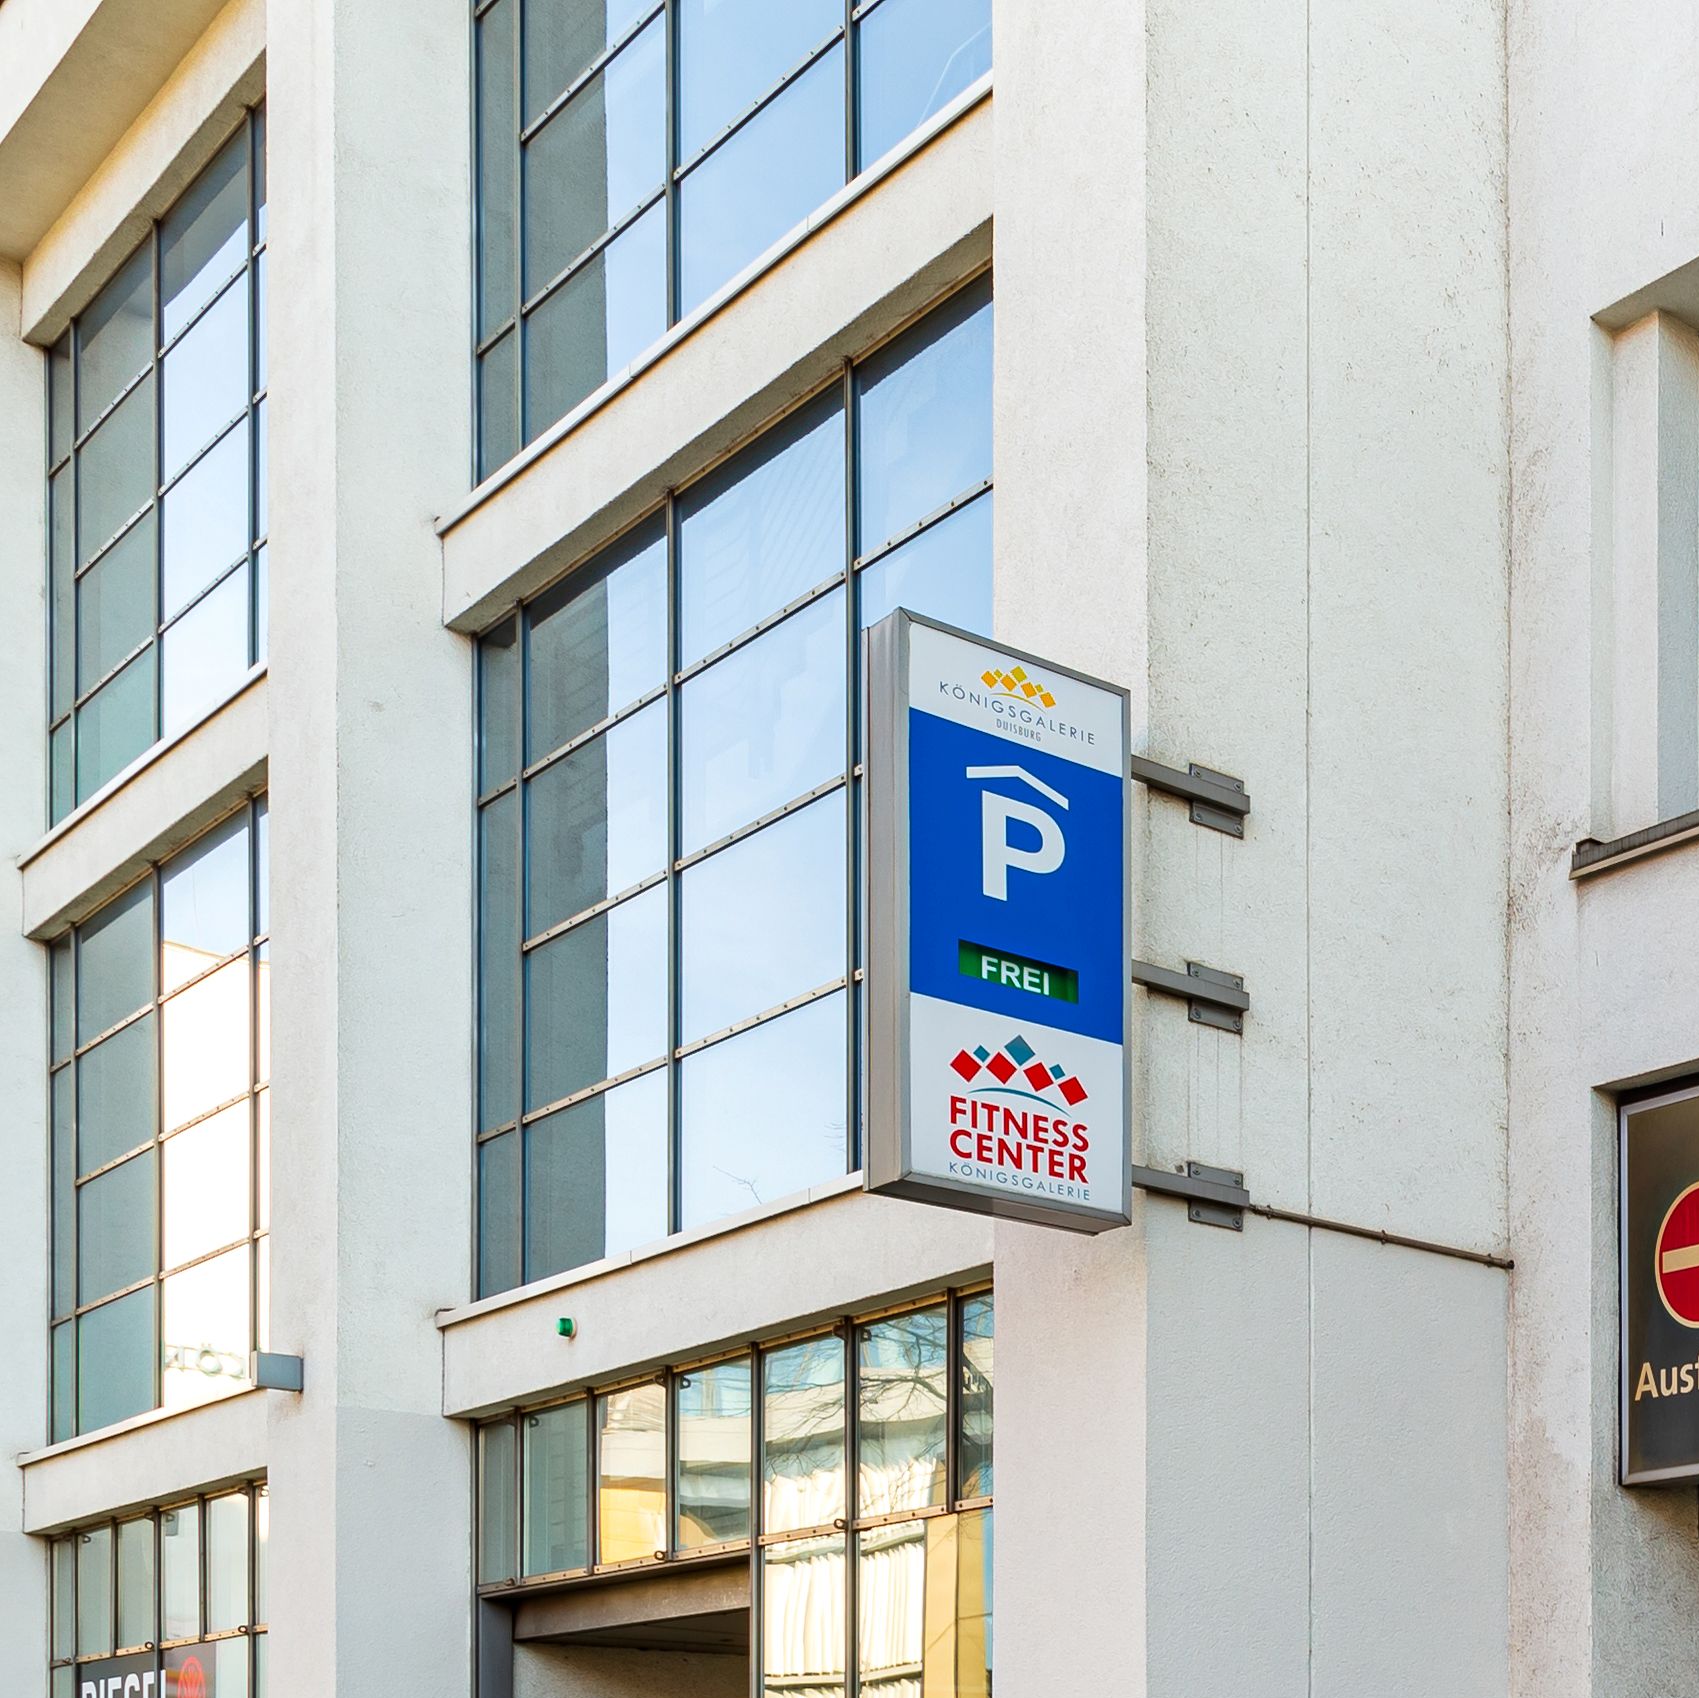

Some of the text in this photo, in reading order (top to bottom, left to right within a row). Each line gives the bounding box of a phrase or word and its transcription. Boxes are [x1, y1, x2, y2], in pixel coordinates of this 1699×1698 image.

[939, 681, 1095, 746] KÖNIGSGALERIE
[996, 718, 1042, 743] DUISBURG
[982, 790, 1066, 902] P
[980, 955, 1051, 997] FREI
[950, 1095, 1090, 1153] FITNESS
[948, 1161, 1091, 1201] KÖNIGSGALERIE
[949, 1129, 1089, 1185] CENTER
